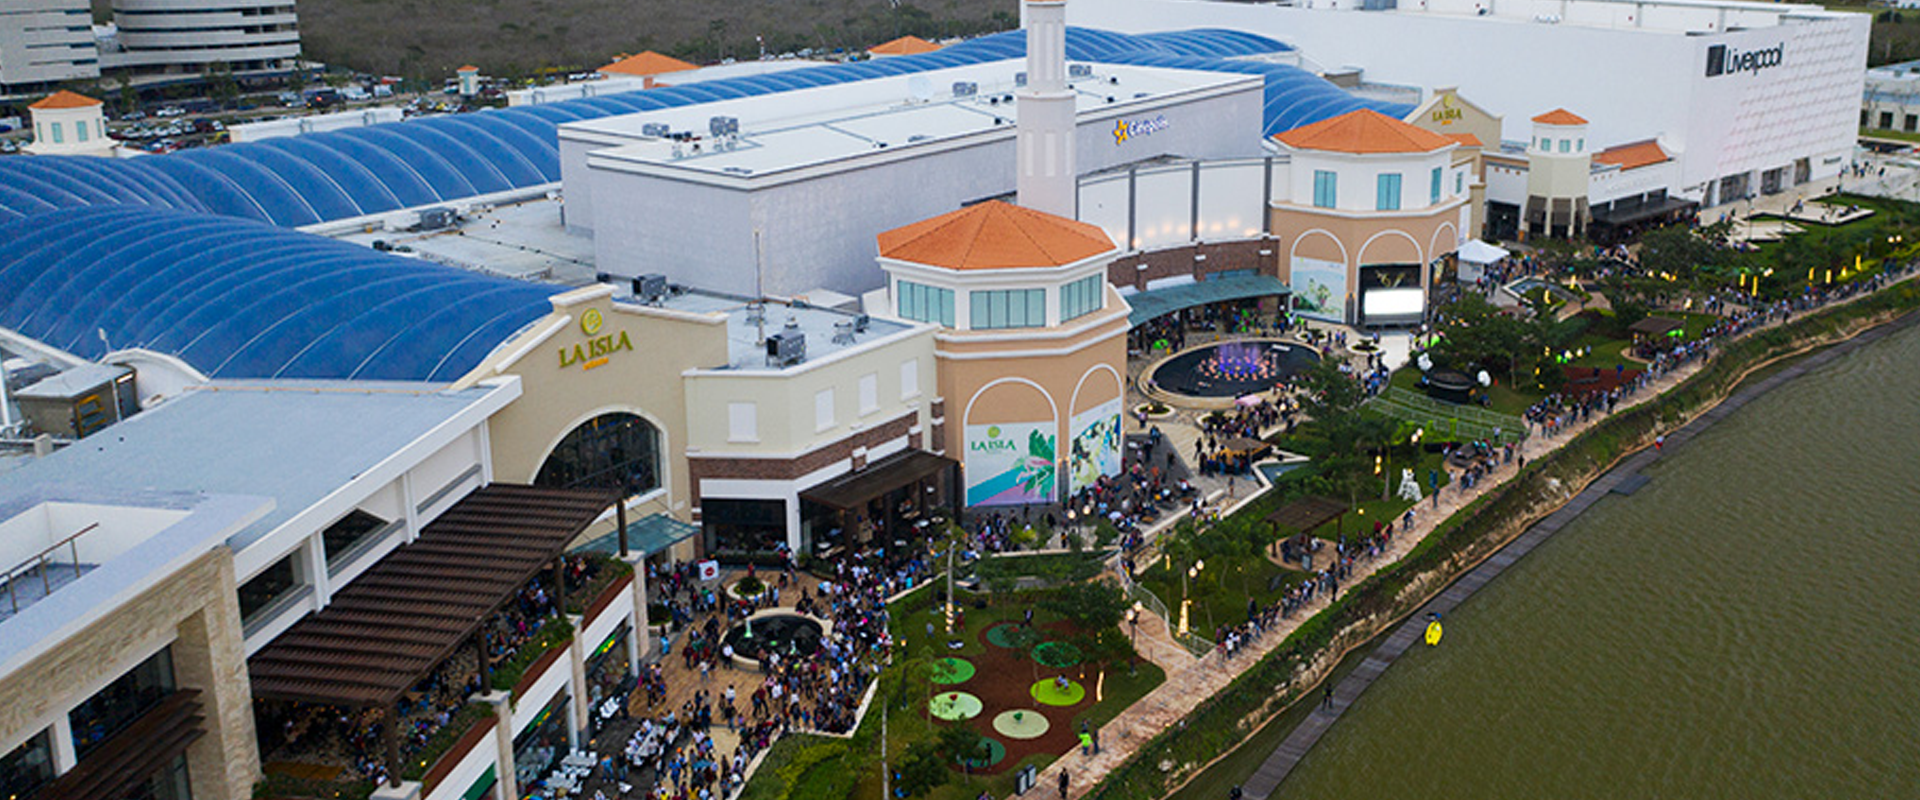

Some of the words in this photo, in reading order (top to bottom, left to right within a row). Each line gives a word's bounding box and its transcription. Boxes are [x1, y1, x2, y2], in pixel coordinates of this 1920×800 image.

[1725, 42, 1784, 76] Liverpool
[558, 344, 587, 368] LA
[587, 330, 634, 359] ISLA
[971, 441, 987, 451] LA
[988, 440, 1017, 451] ISLA
